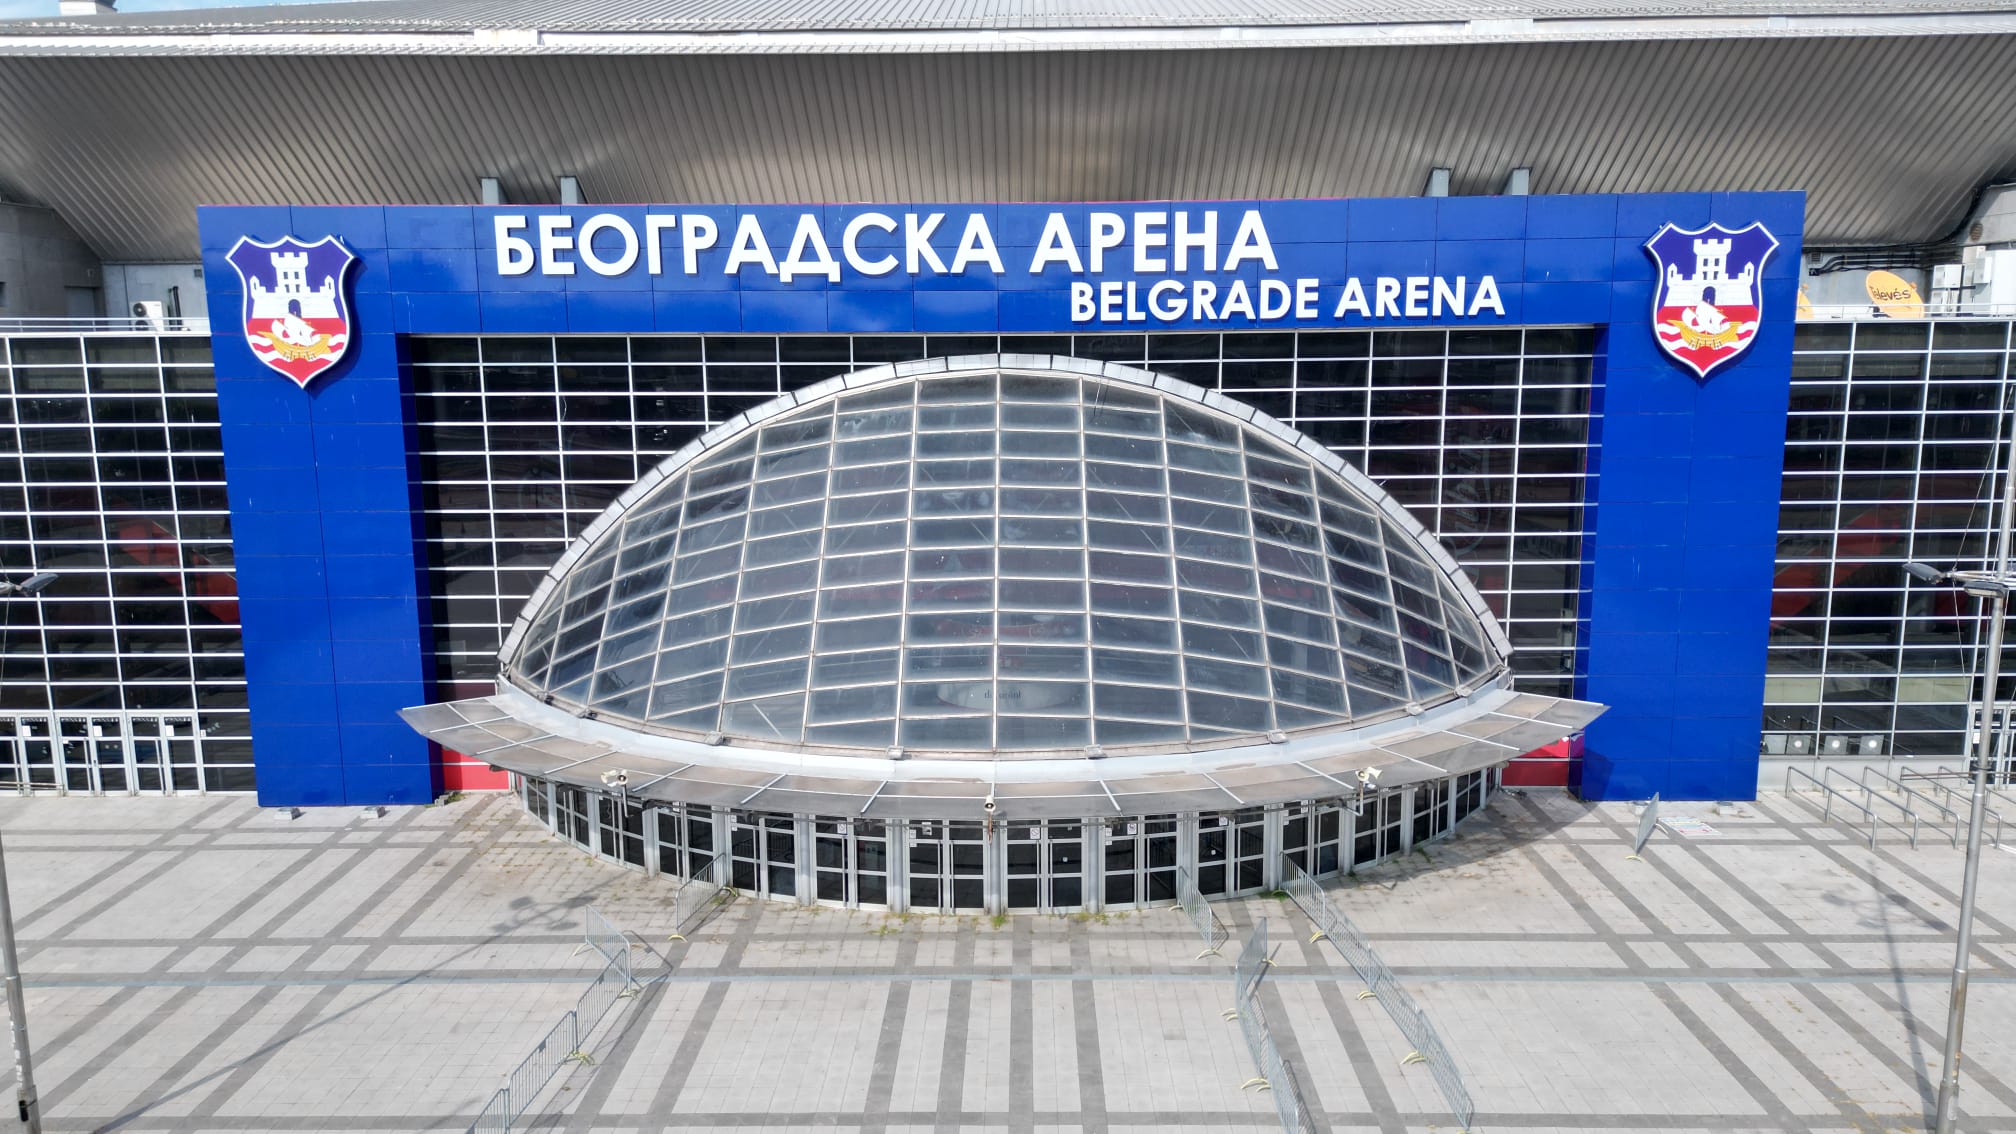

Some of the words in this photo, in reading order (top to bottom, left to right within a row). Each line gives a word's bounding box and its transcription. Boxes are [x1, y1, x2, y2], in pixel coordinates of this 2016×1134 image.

[493, 211, 1006, 283] БЕОГРАДСКА
[1028, 209, 1279, 274] АРЕНА
[1070, 276, 1321, 322] BELGRADE
[1333, 274, 1507, 319] ARENA
[1869, 286, 1912, 301] Televés
